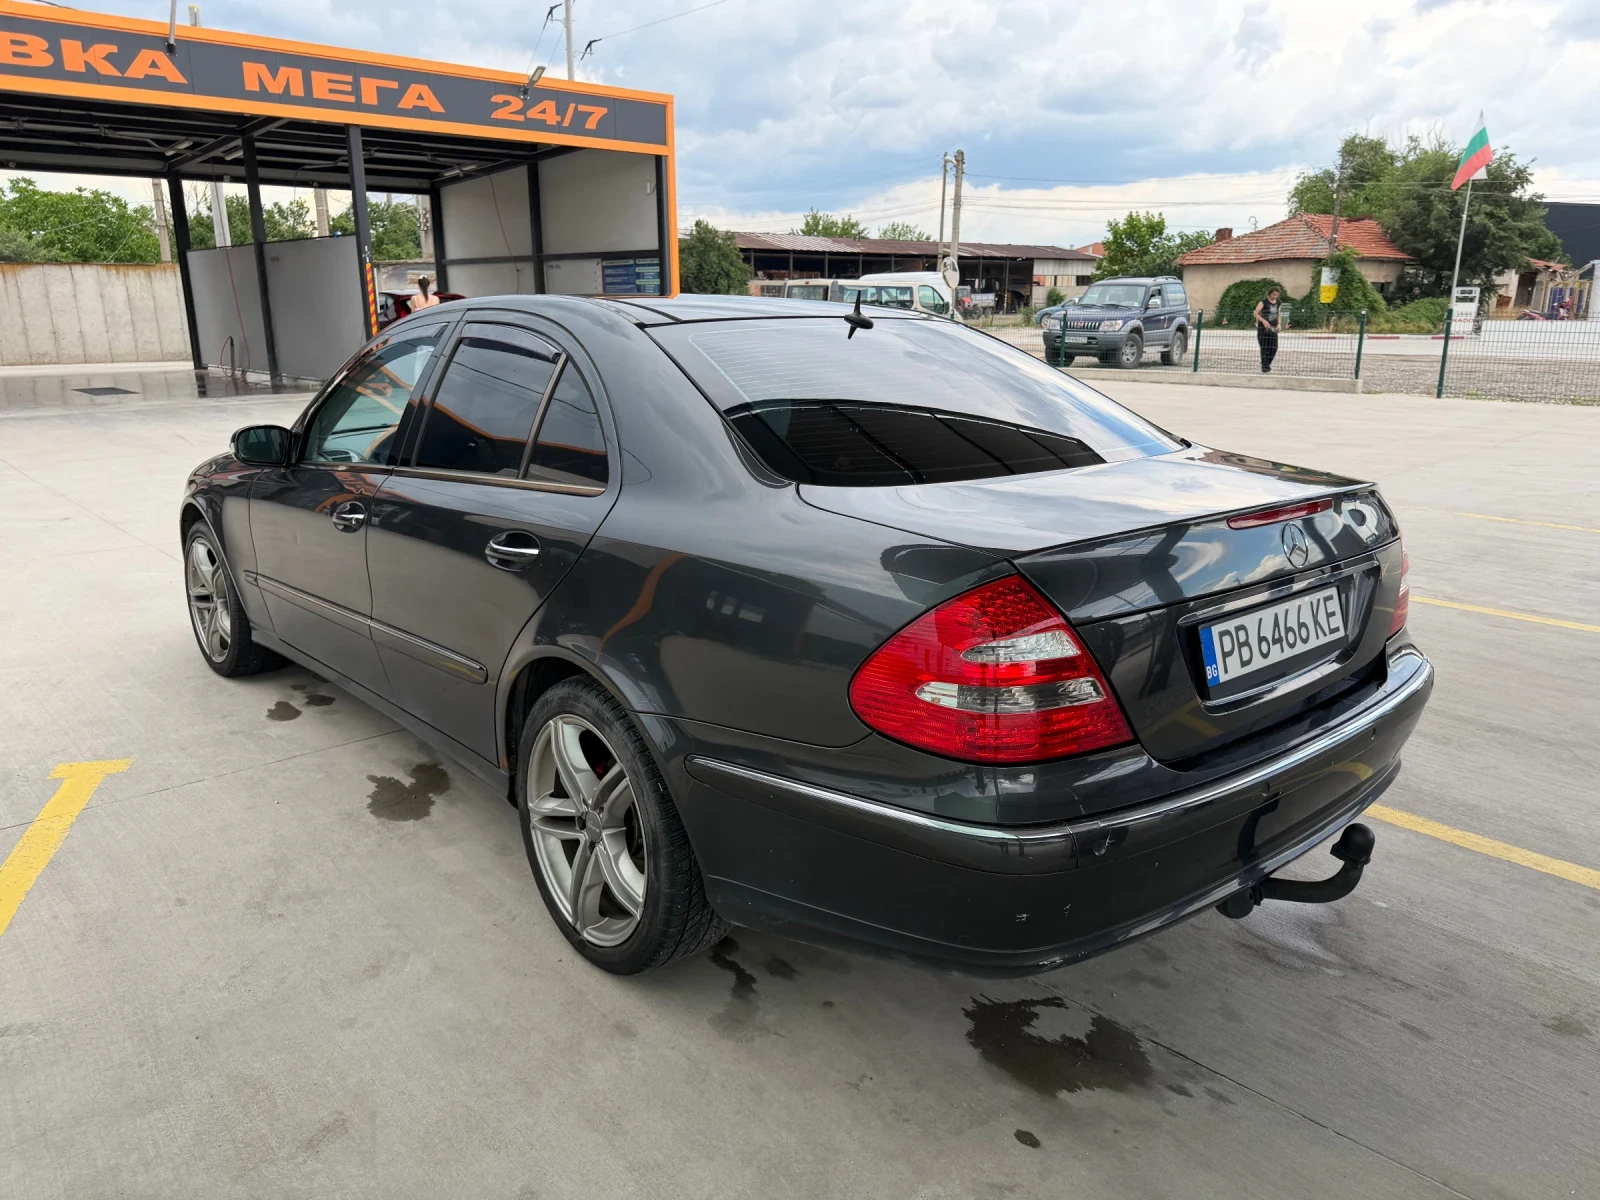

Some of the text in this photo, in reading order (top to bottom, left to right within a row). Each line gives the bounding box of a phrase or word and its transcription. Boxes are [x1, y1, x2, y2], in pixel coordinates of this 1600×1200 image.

[242, 61, 446, 113] МЕГА
[490, 94, 608, 130] 24/7
[1218, 594, 1341, 675] PB 6466 KE
[1206, 665, 1218, 680] BG
